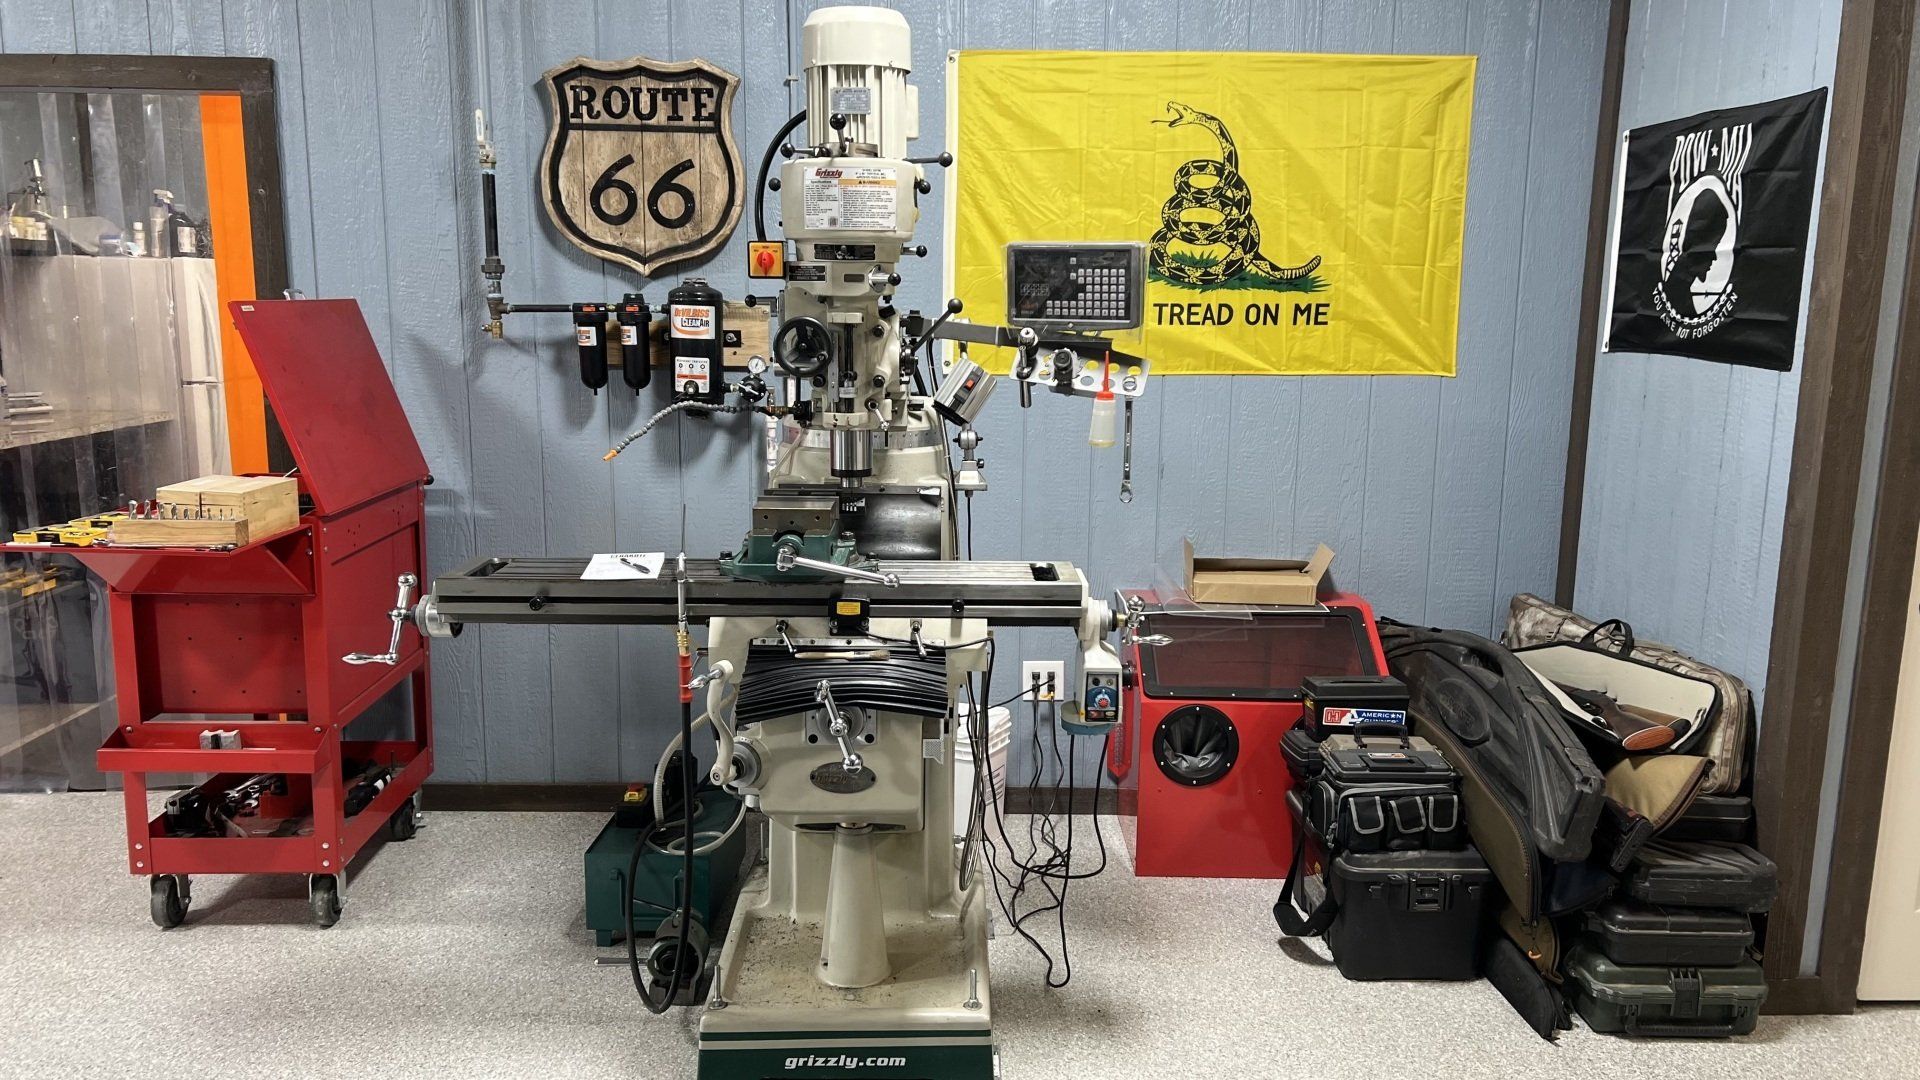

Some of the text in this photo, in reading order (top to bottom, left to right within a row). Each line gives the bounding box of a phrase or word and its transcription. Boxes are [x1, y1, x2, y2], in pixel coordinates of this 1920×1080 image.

[569, 85, 716, 122] ROUTE
[589, 153, 696, 230] 66
[815, 168, 843, 179] Grizzly
[1664, 122, 1752, 229] POW MIA
[1152, 303, 1331, 326] TREAD ON ME
[1652, 286, 1738, 339] YOU ARE NOT FORGOTTEN
[784, 1054, 907, 1069] grizzly.com
